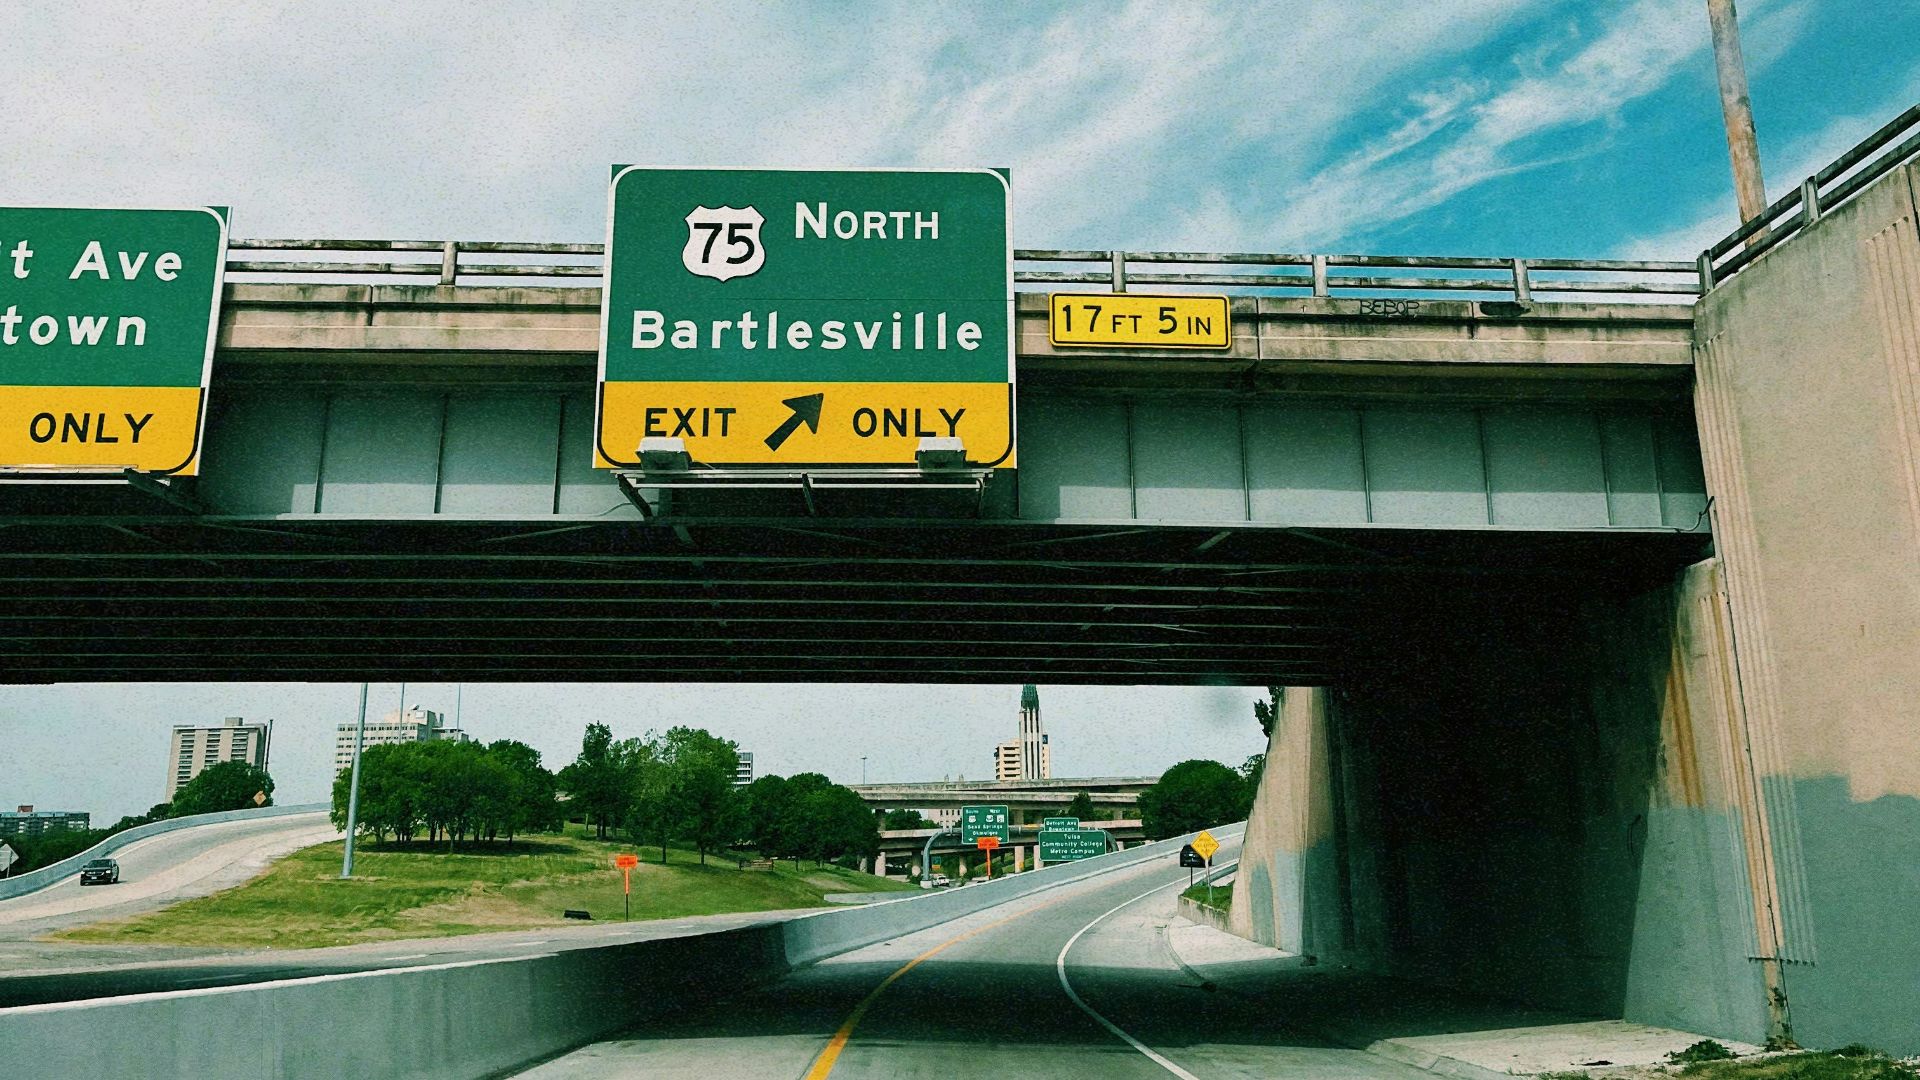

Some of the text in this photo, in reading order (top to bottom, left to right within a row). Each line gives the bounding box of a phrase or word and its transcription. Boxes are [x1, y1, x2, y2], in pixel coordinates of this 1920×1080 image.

[693, 202, 939, 265] 75 NORTH
[68, 240, 182, 282] Ave
[631, 309, 983, 351] Bartlesville
[1062, 304, 1211, 336] 17 FT 5 IN
[29, 412, 155, 444] ONLY
[643, 407, 967, 438] EXIT ONLY
[1080, 840, 1103, 848] College
